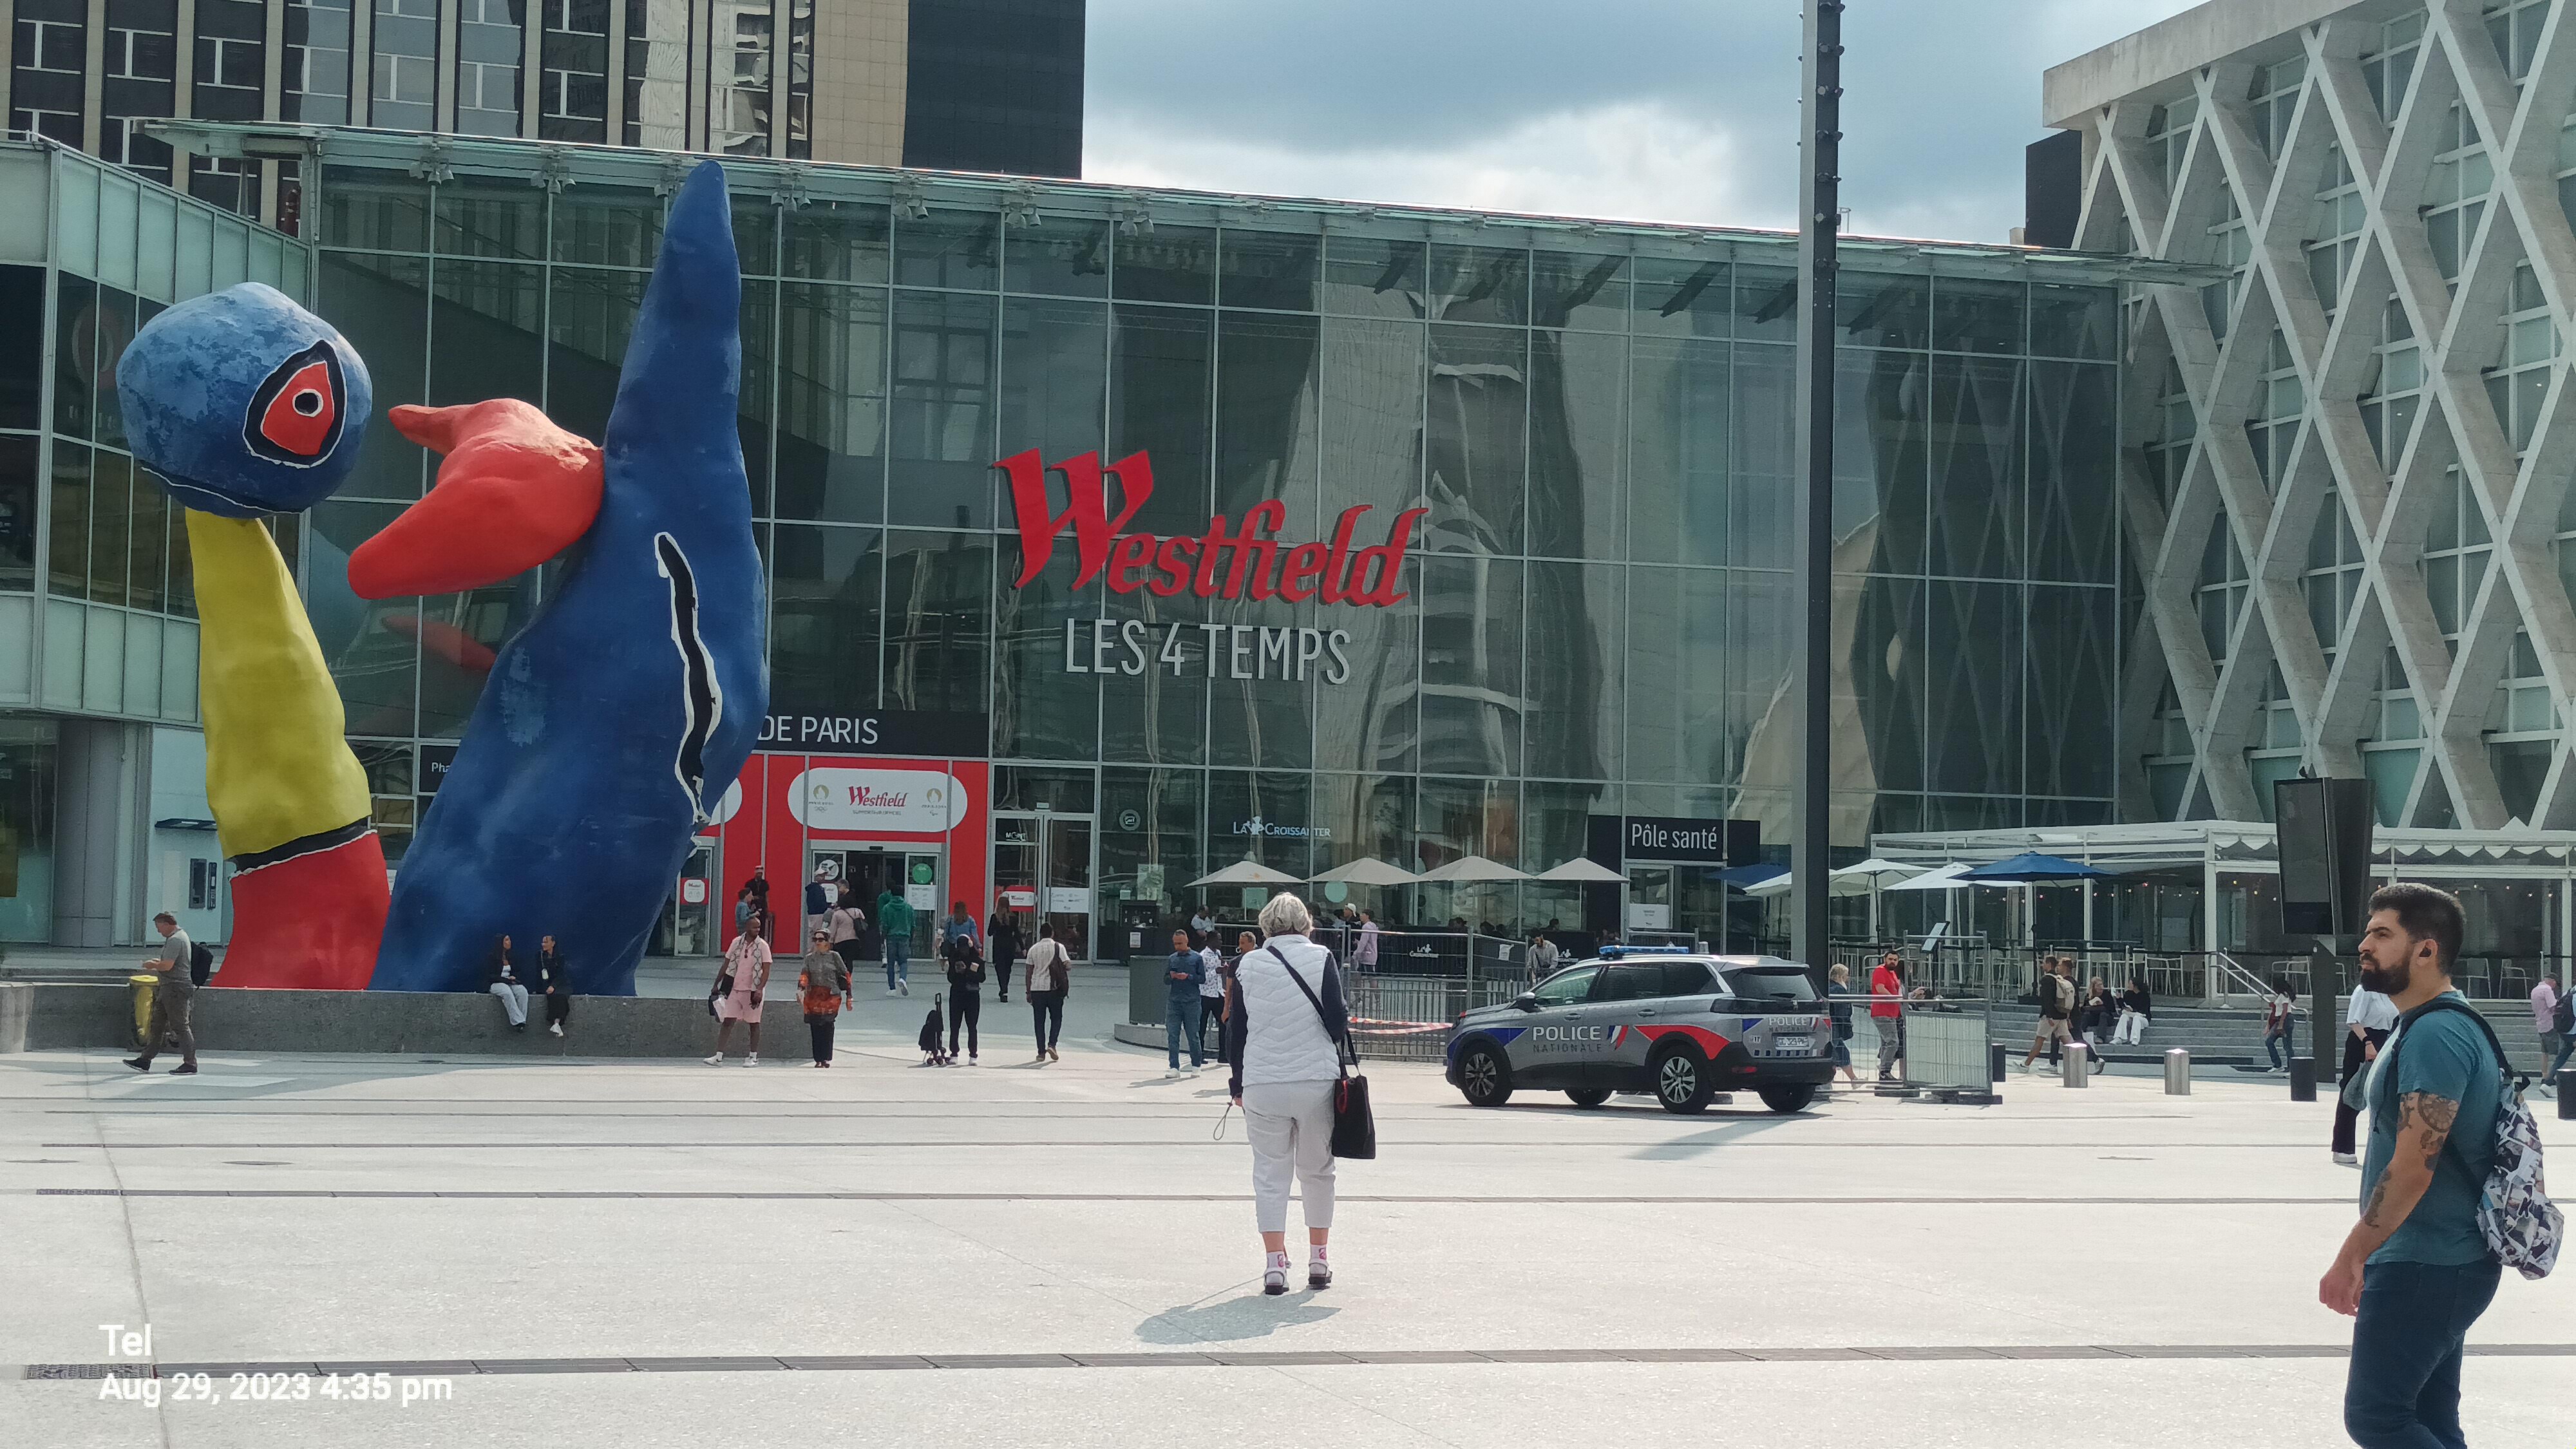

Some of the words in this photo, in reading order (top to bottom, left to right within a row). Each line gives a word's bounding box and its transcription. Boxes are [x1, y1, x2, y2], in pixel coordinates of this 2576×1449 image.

[992, 447, 1428, 607] Westfield
[1066, 618, 1146, 676] LES
[1160, 622, 1185, 676] 4
[1199, 623, 1351, 685] TEMPS
[757, 715, 793, 741] DE
[801, 716, 878, 744] PARIS
[848, 786, 909, 807] Westfield
[1631, 823, 1667, 848] Pôle
[1672, 826, 1717, 850] santé
[1533, 1026, 1602, 1041] POLICE
[1768, 1017, 1807, 1026] POLICE
[1533, 1043, 1602, 1053] NATIONALE
